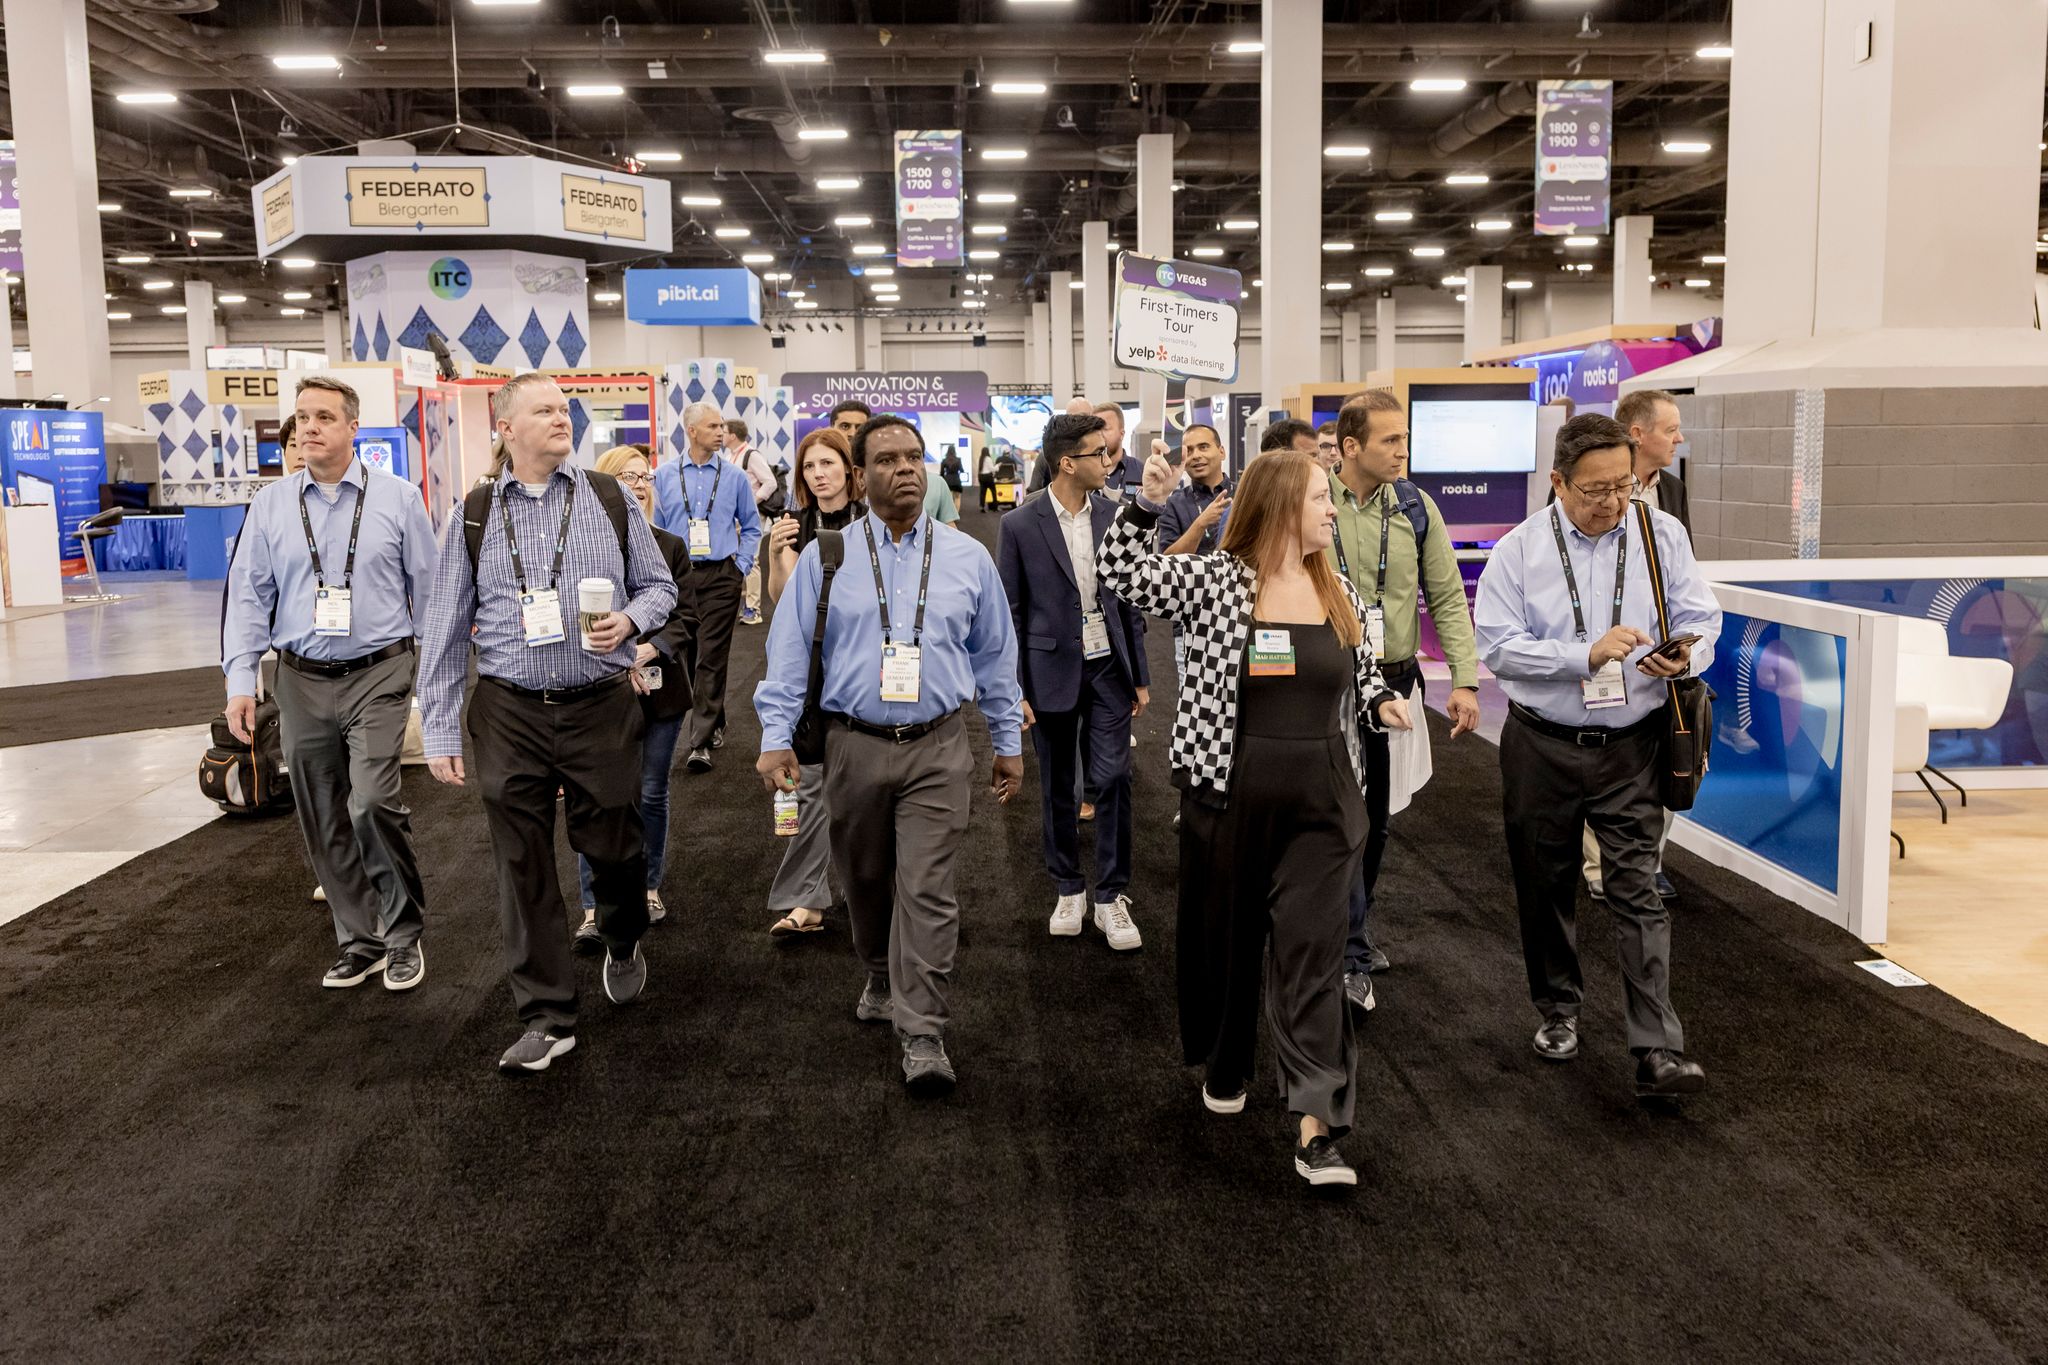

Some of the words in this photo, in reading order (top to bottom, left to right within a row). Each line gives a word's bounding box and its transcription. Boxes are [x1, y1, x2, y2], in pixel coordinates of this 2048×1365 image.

[1549, 122, 1577, 134] 1800
[1549, 136, 1577, 147] 1900
[906, 167, 932, 178] 1500
[361, 182, 474, 197] FEDERATO
[906, 180, 932, 190] 1700
[570, 188, 638, 212] FEDERATO
[378, 202, 459, 218] Biergarten
[580, 210, 628, 229] Biergarten
[434, 271, 466, 287] ITC
[1158, 270, 1174, 280] ITC
[1176, 273, 1207, 287] VEGAS
[658, 284, 719, 306] pibit.ai
[1140, 298, 1218, 322] First-Timers
[1164, 318, 1194, 334] Tour
[1128, 346, 1155, 360] yelp
[1171, 354, 1189, 364] data
[1191, 356, 1224, 371] licensing
[1584, 365, 1606, 387] roots
[1608, 360, 1618, 384] ai
[734, 375, 754, 389] ATO
[826, 377, 927, 391] INNOVATION
[932, 376, 944, 390] &
[907, 393, 958, 406] STAGE
[1442, 484, 1473, 494] roots
[1476, 482, 1488, 494] ai
